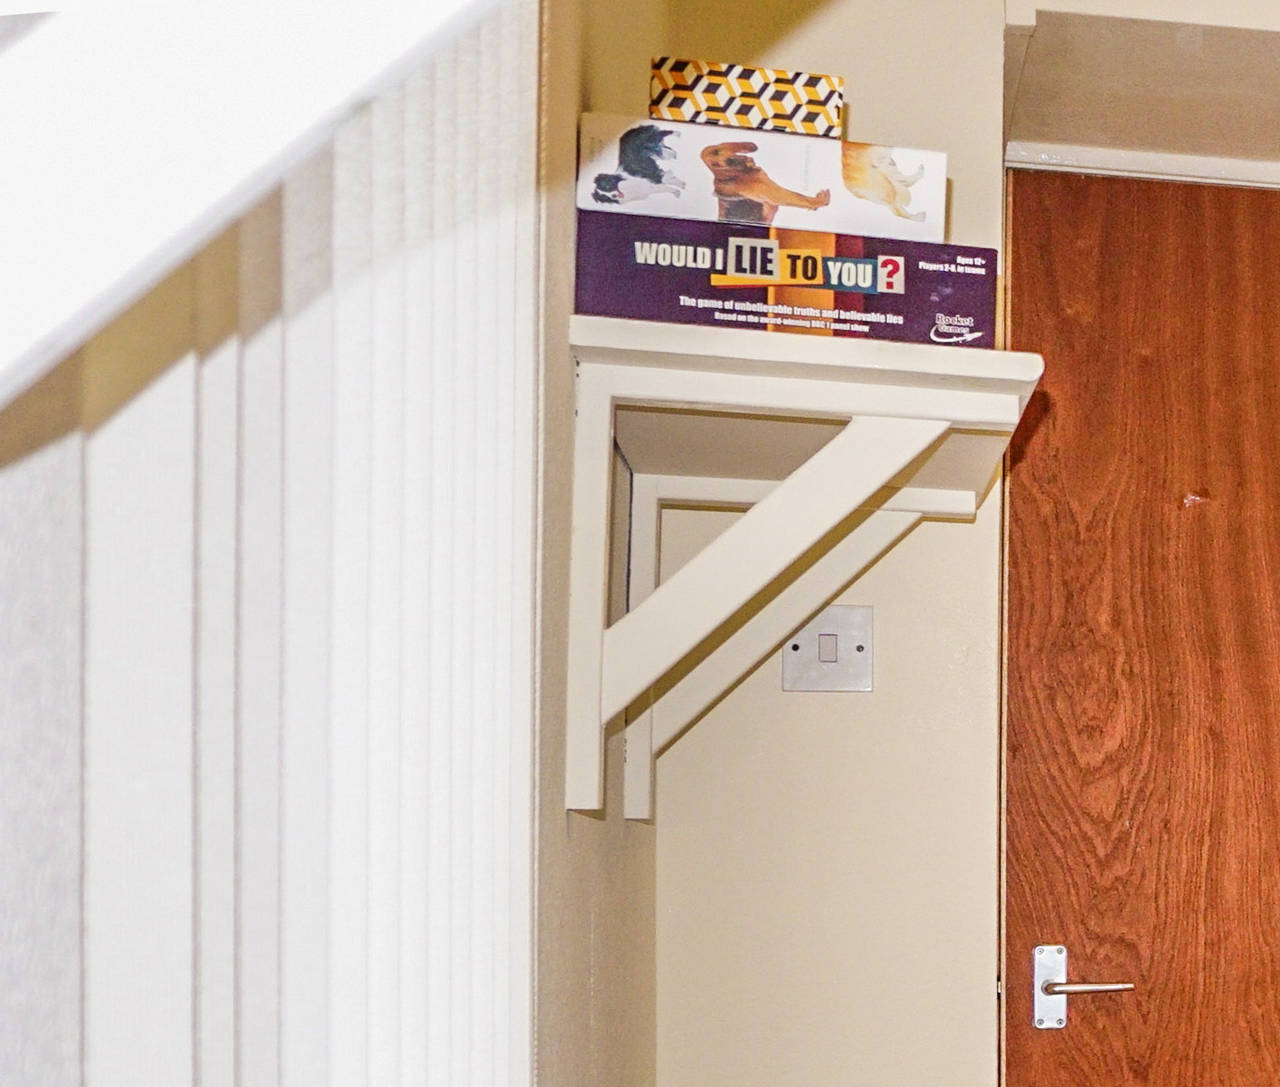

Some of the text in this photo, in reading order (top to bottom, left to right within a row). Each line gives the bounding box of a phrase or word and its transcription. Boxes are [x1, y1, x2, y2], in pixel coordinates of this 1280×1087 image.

[635, 241, 711, 269] WOULD
[715, 248, 724, 270] I
[735, 244, 774, 276] LIE
[786, 253, 818, 281] TO
[679, 295, 904, 325] The game of unbelievable truths and believable lies
[935, 312, 974, 327] Rocket
